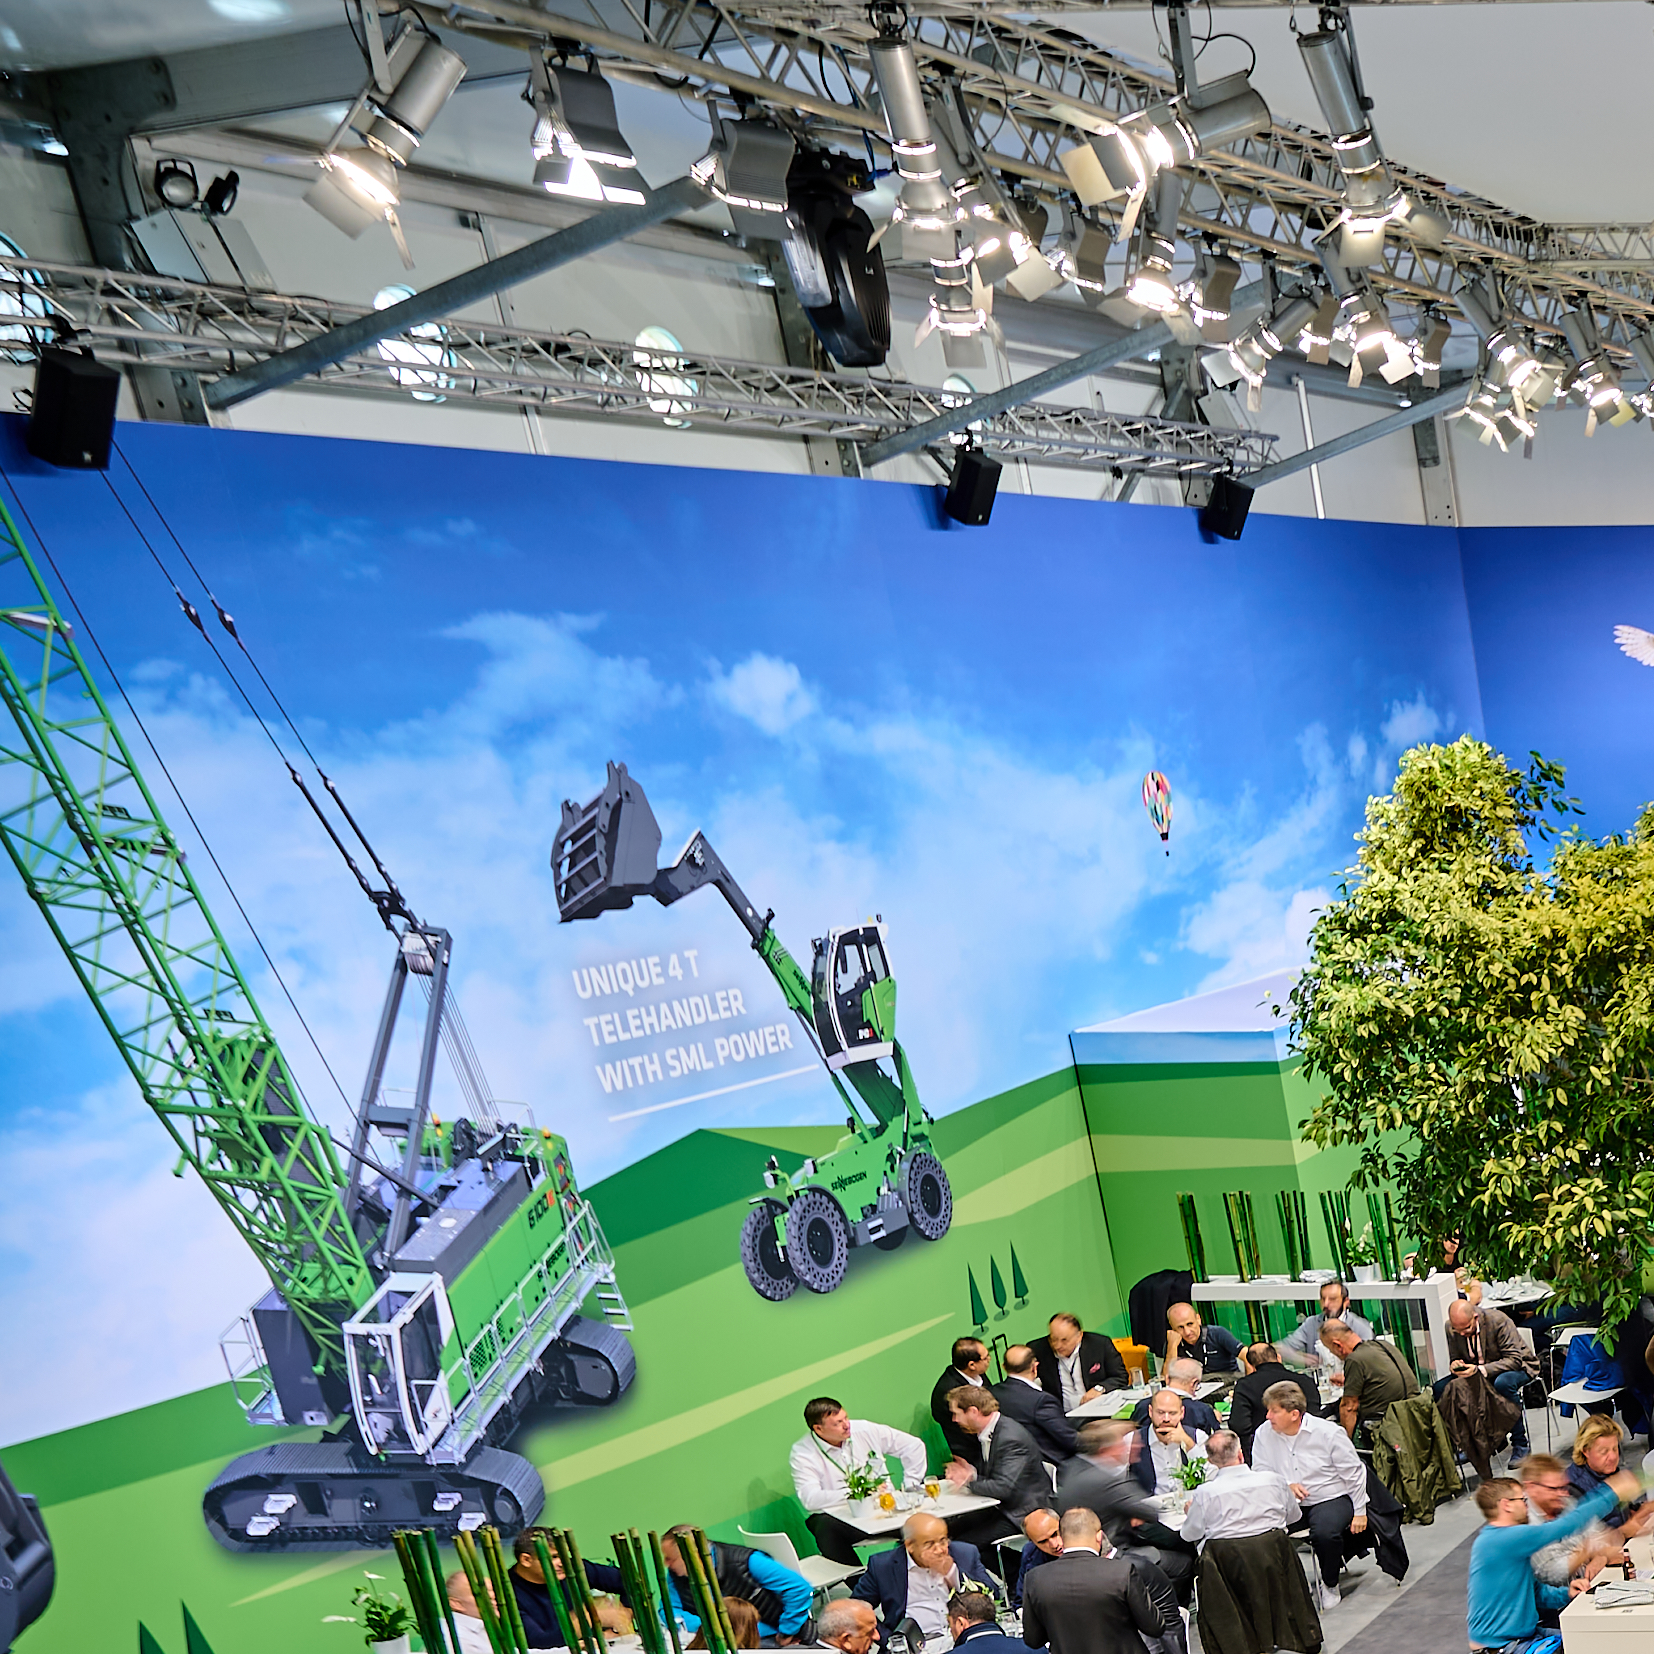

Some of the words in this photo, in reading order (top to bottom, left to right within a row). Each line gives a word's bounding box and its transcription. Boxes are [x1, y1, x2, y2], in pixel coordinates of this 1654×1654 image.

[572, 956, 665, 999] UNIQUE
[668, 953, 683, 981] 4
[684, 949, 699, 978] T
[583, 988, 747, 1046] TELEHANDLER
[595, 1052, 663, 1093] WITH
[665, 1042, 714, 1078] SML
[714, 1023, 794, 1066] POWER
